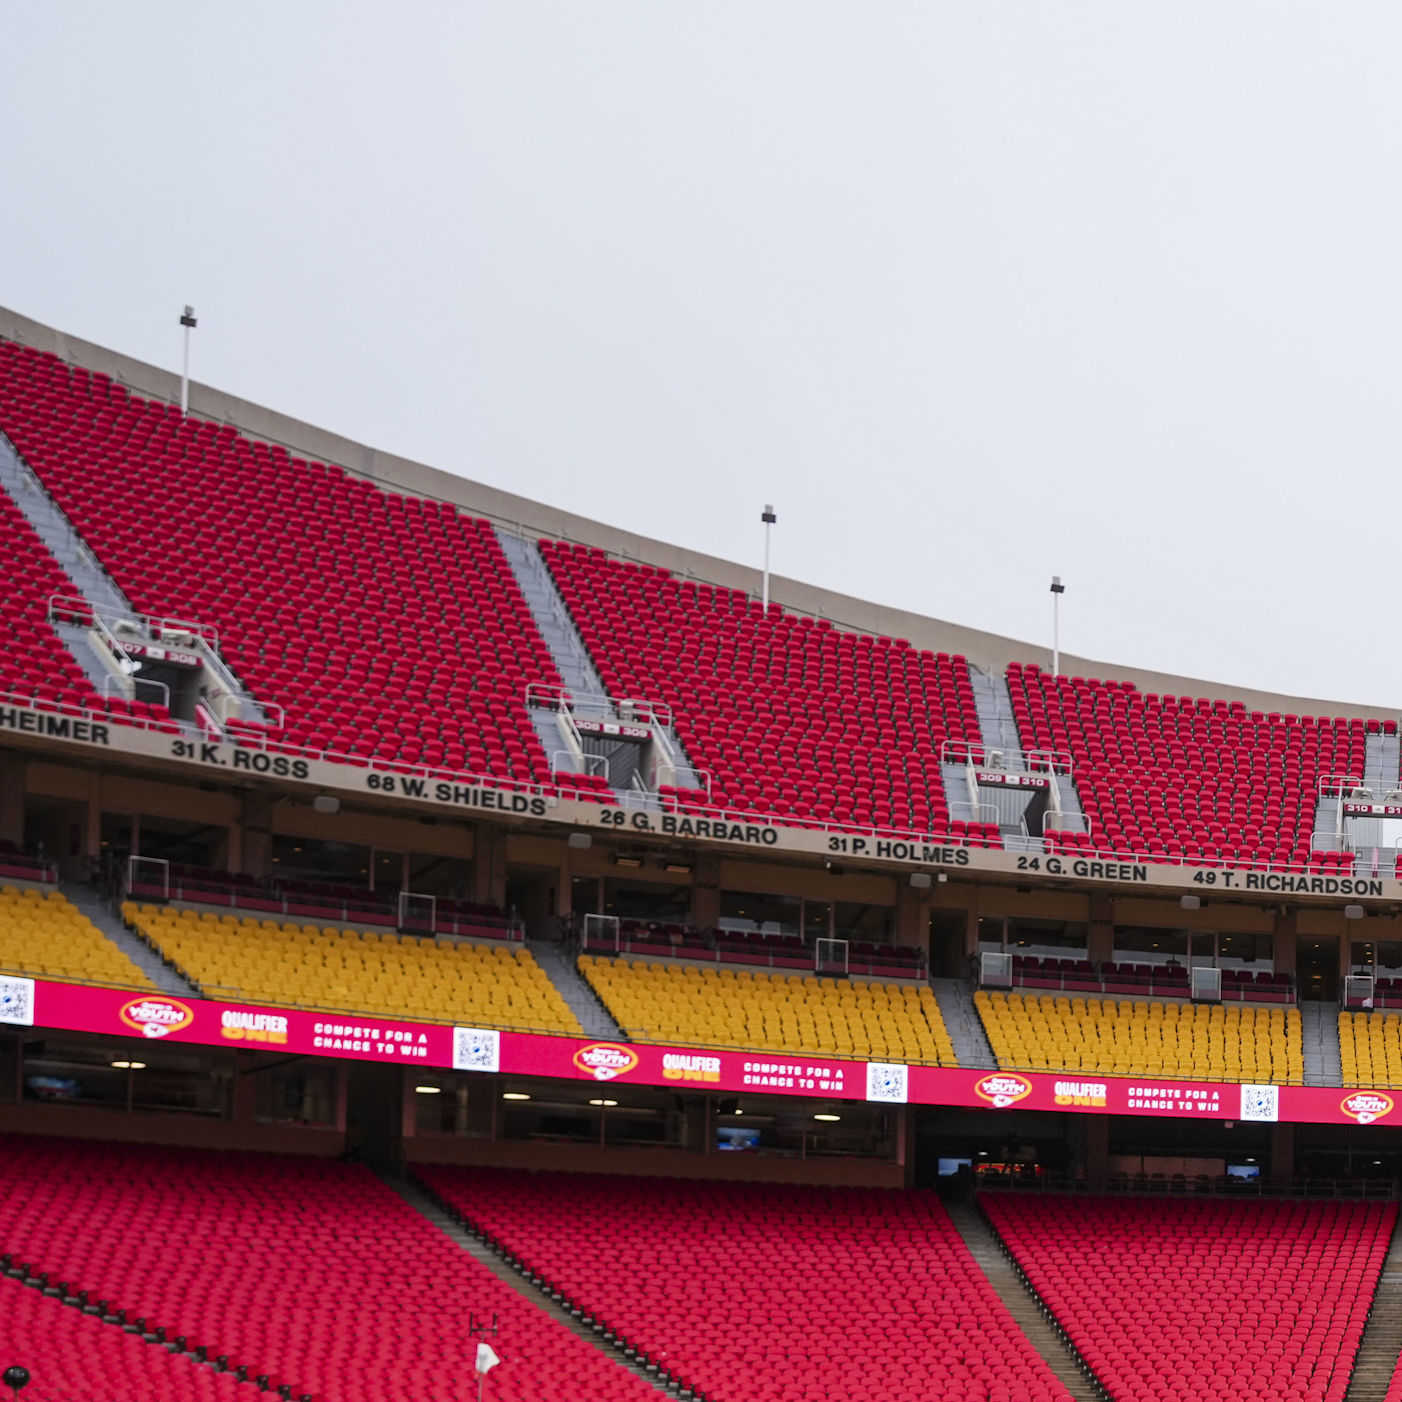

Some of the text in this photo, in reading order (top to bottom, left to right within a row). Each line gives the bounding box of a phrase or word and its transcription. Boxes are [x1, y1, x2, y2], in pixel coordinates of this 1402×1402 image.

[172, 741, 308, 778] 31 K. ROSS
[1022, 777, 1044, 787] 310
[367, 774, 546, 816] 68 W. SHIELDS
[1347, 804, 1368, 813] 310
[601, 810, 778, 845] 26 G. BARBARO
[829, 837, 968, 864] 31 P. HOLMES
[1018, 857, 1146, 881] 24 G. GREEN
[1194, 871, 1383, 896] 49 T. RICHARDSON
[582, 1053, 629, 1062] YOUTH
[663, 1054, 720, 1072] QUALIFIER
[663, 1069, 720, 1082] ONE
[743, 1062, 844, 1079] COMPETE FOR A
[743, 1074, 844, 1091] CHANCE TO WIN
[1348, 1100, 1387, 1108] YOUTH
